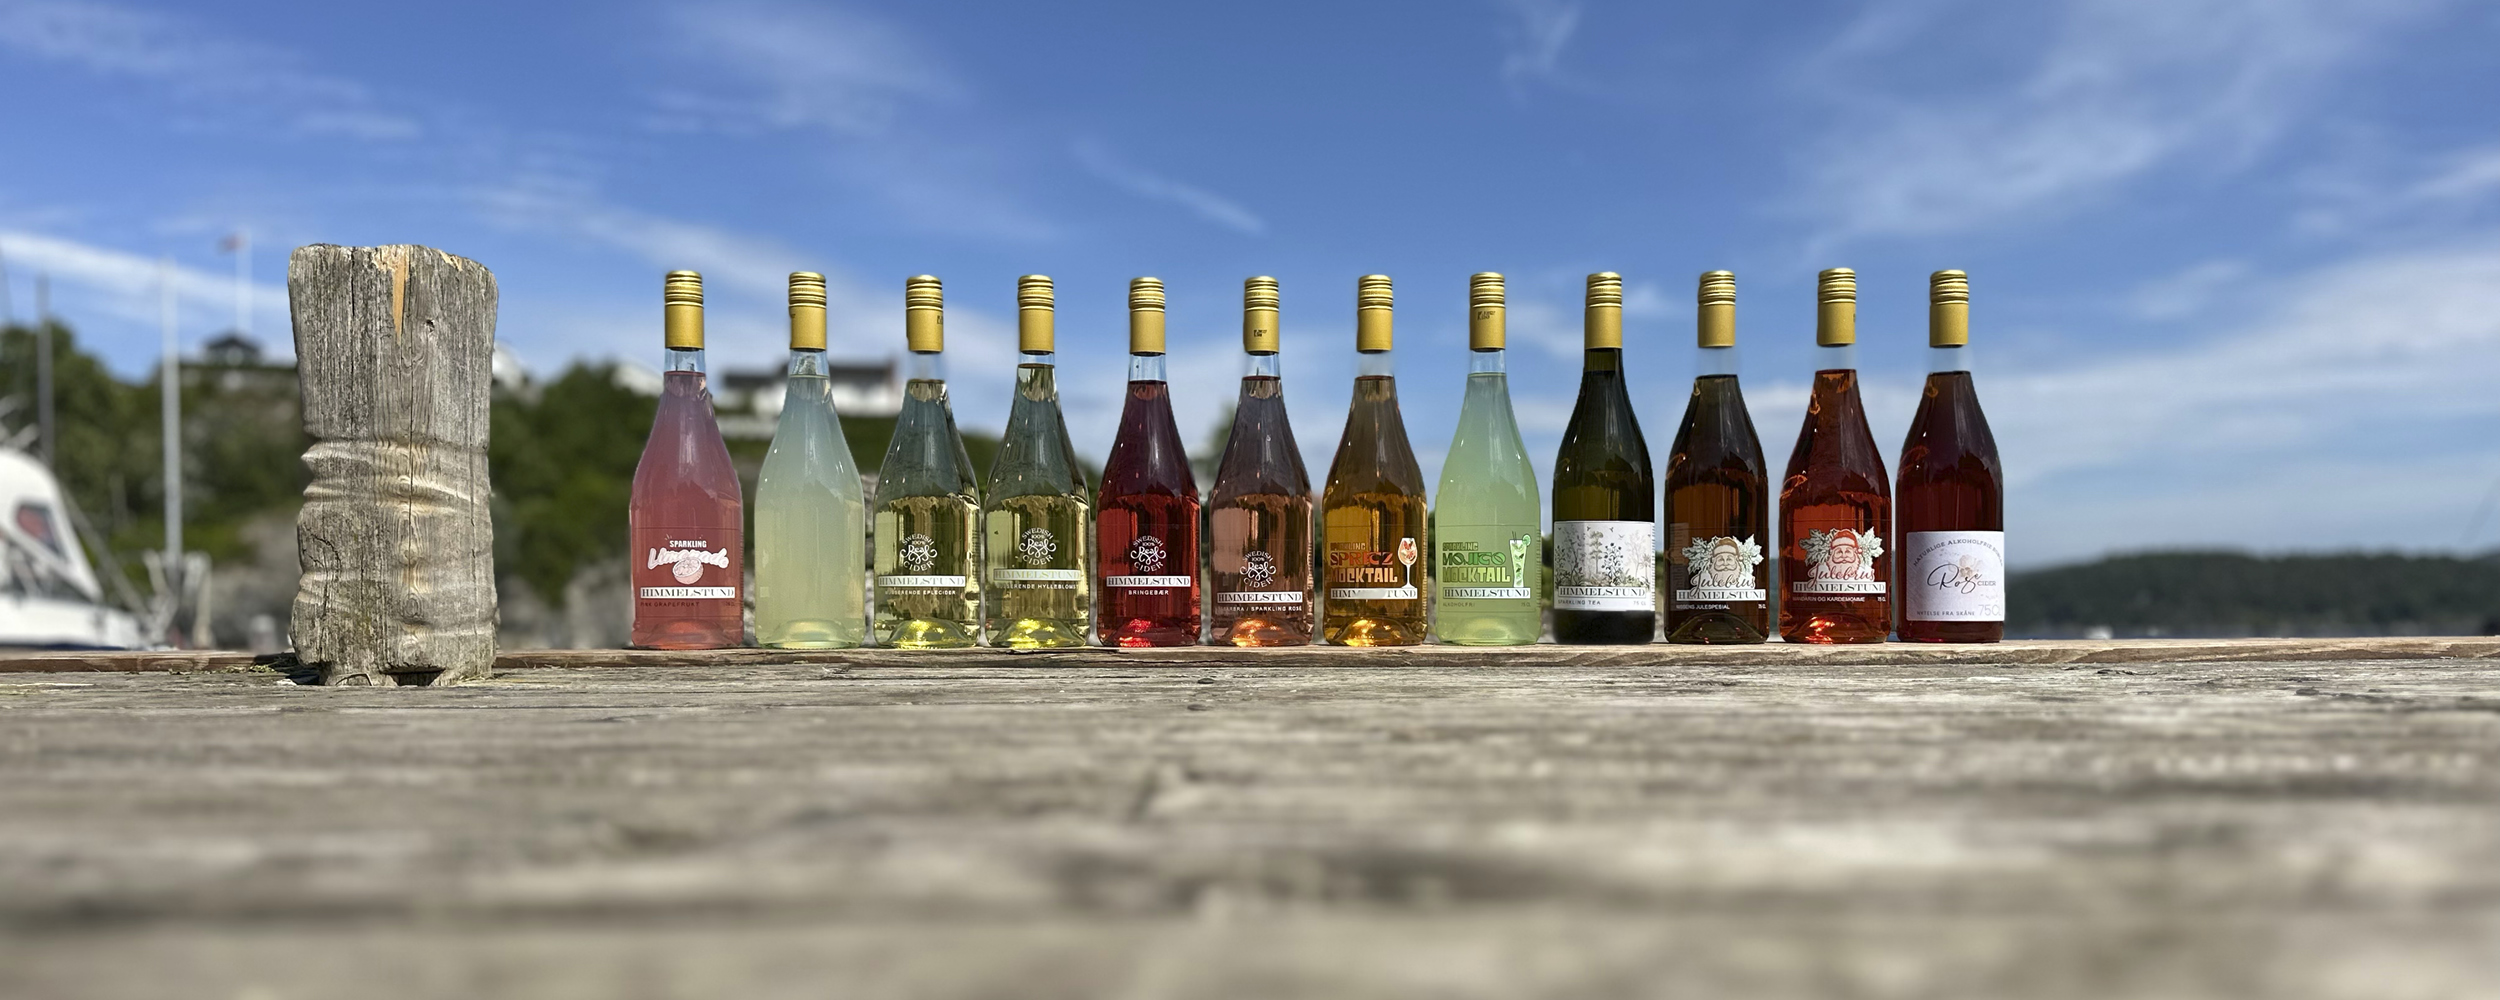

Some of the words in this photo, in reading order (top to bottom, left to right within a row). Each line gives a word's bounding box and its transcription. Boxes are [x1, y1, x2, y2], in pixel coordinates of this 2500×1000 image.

[901, 533, 935, 546] SWEDISH
[1021, 527, 1054, 540] SWEDISH
[669, 540, 707, 548] SPARKLING
[1132, 535, 1164, 548] SWEDISH
[1242, 550, 1274, 563] SWEDISH
[1913, 541, 1945, 567] NATURLIGE
[1947, 539, 1993, 549] ALKOHOLFRIE
[903, 560, 935, 572] CIDER
[1022, 554, 1054, 566] CIDER
[1133, 561, 1164, 573] CIDER
[994, 570, 1080, 580] HIMMELSTUND
[1331, 567, 1398, 583] MOCKTAIL
[1443, 566, 1511, 583] MOCKTAIL
[1808, 562, 1875, 588] Julebrus
[1926, 563, 1982, 594] Rose
[880, 577, 965, 586] HIMMELSTUND
[1107, 577, 1190, 586] HIMMELSTUND
[1243, 577, 1274, 588] CIDER
[1690, 571, 1755, 597] Julebrus
[641, 588, 735, 598] HIMMELSTUND
[1218, 593, 1302, 602] HIMMELSTUND
[1331, 590, 1416, 598] HIMTUND
[1444, 589, 1529, 598] HIMMELSTUND
[1560, 587, 1645, 597] HIMMELSTUND
